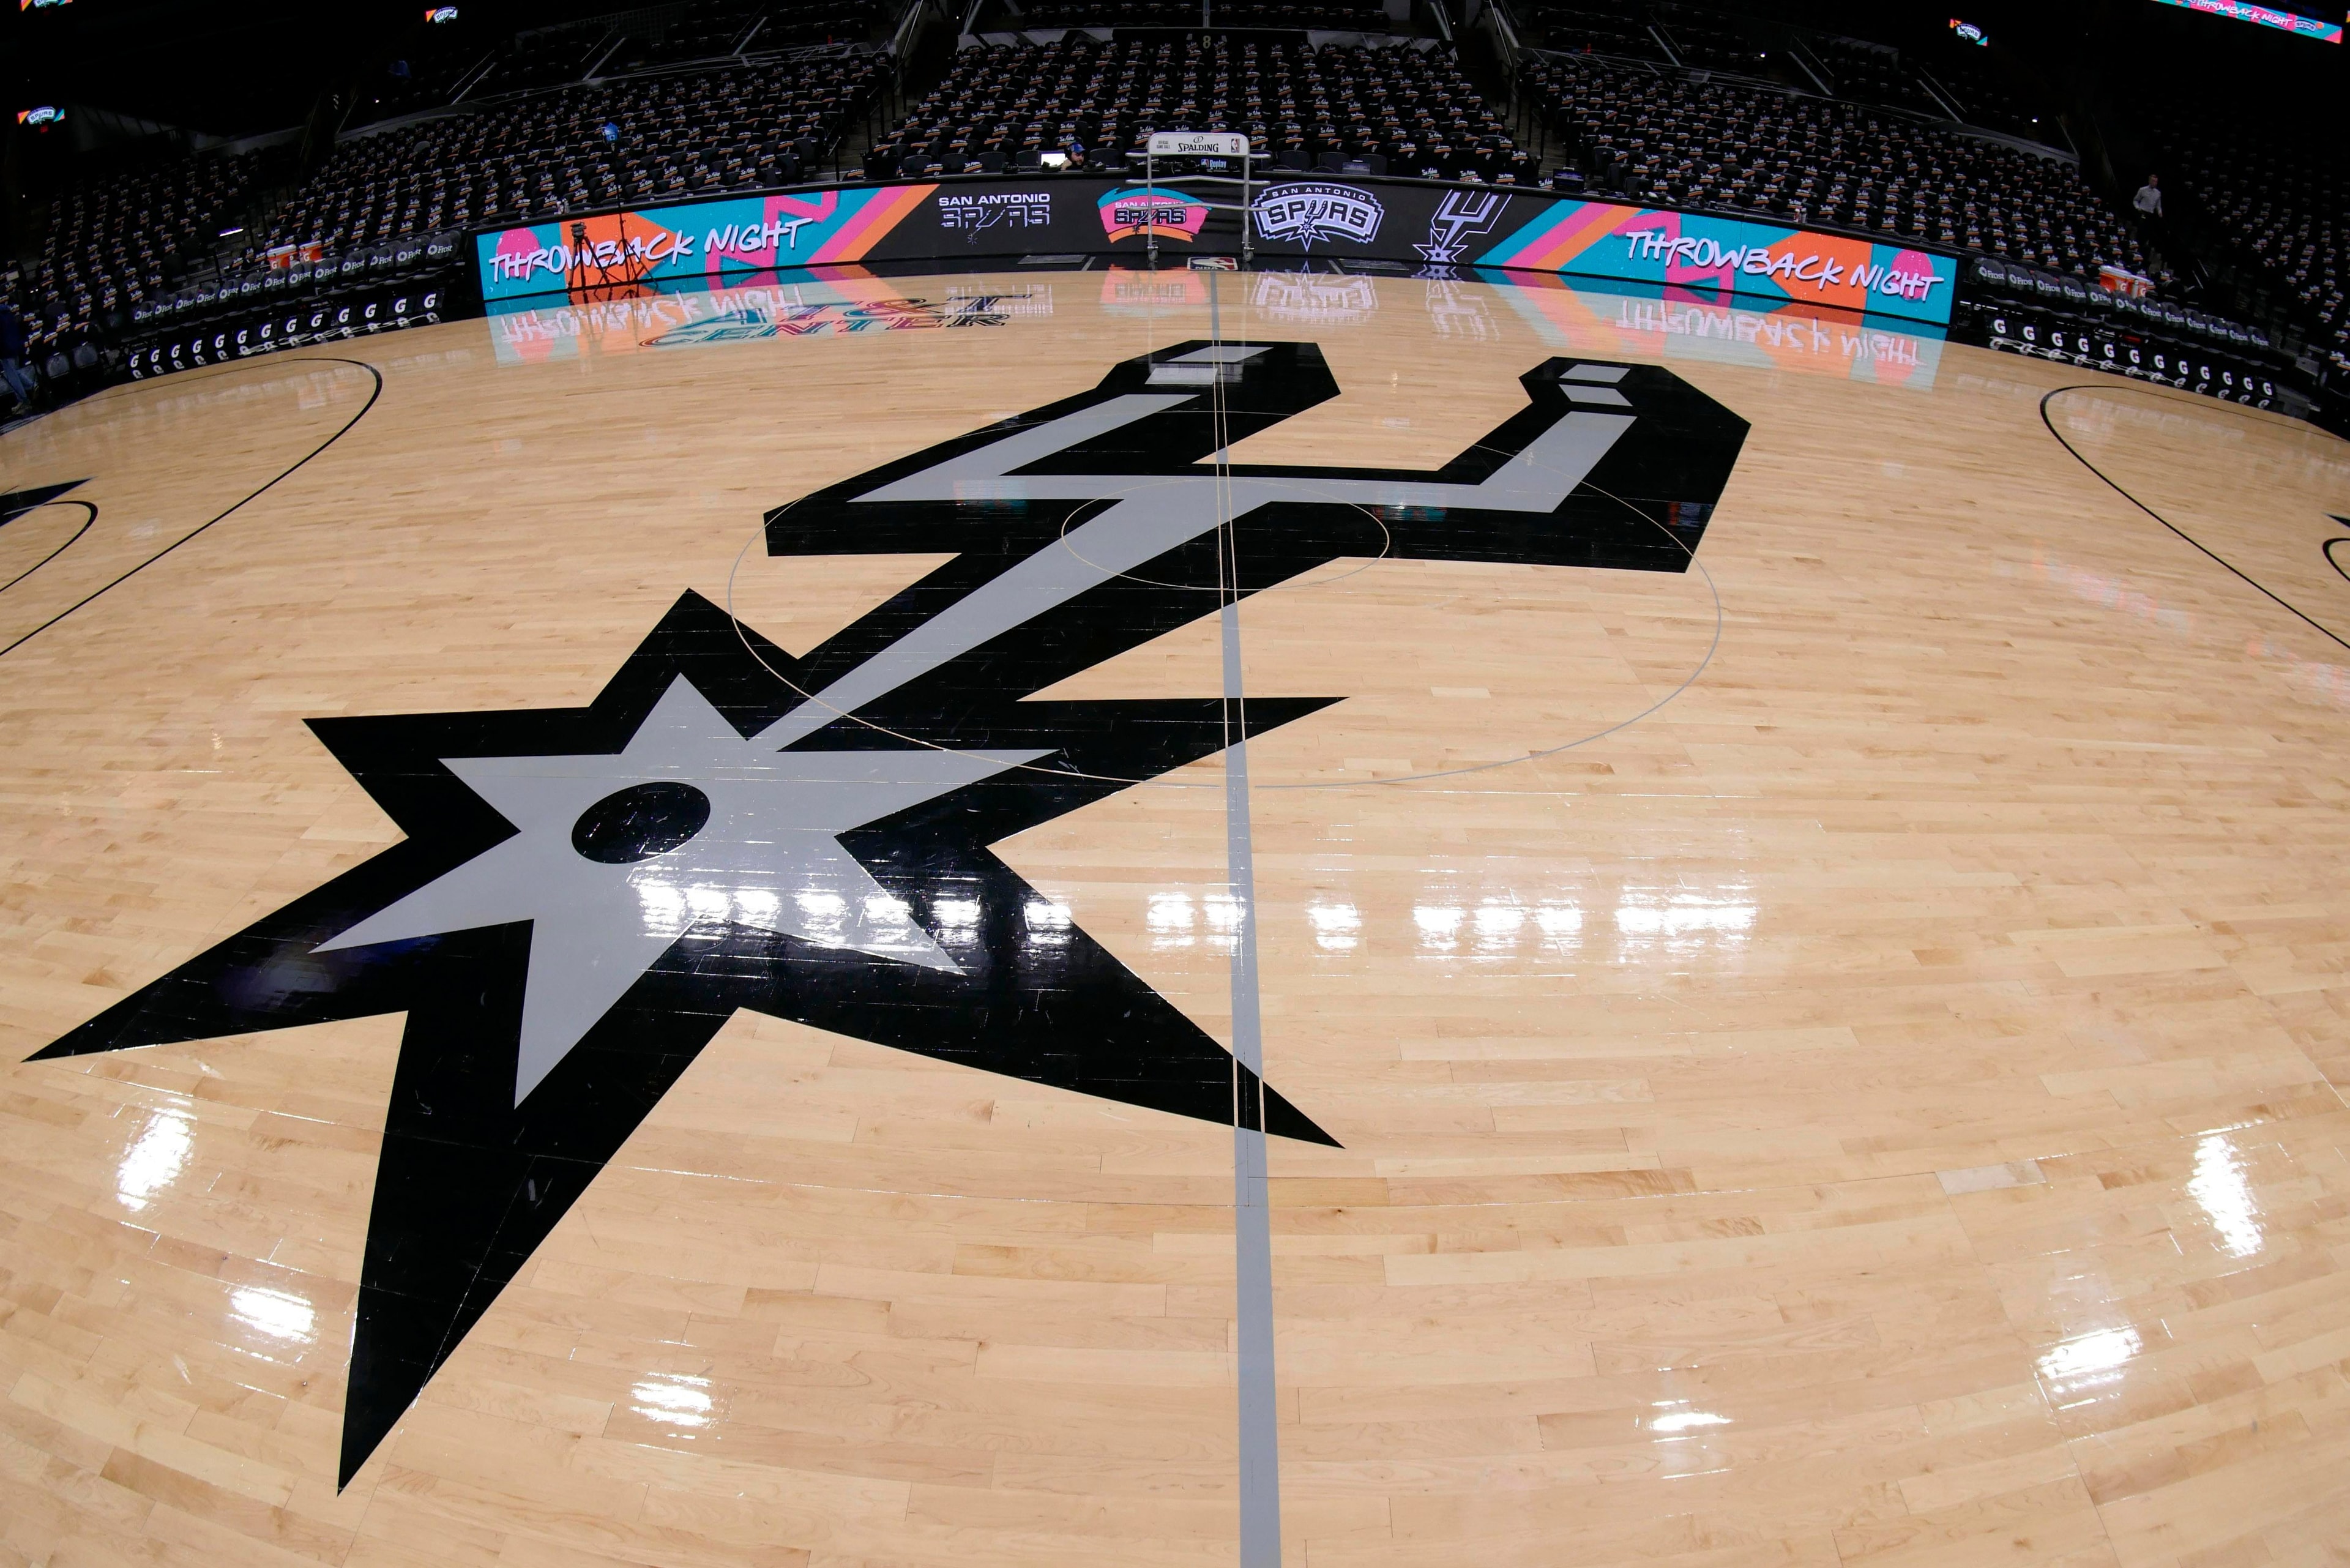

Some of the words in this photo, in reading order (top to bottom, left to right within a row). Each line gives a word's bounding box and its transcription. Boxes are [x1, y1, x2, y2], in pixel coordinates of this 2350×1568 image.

[2261, 14, 2294, 26] NIGHT
[1203, 35, 1211, 50] 8
[1178, 143, 1218, 152] SPALDING
[1209, 159, 1227, 169] Replay
[939, 196, 973, 206] SAN
[977, 193, 1051, 204] ANTONIO
[1272, 187, 1299, 198] SAN
[1305, 187, 1366, 201] ANTONIO
[408, 248, 422, 259] Frost
[438, 245, 453, 254] Frost
[489, 230, 695, 283] THROWBACK
[704, 217, 813, 253] NIGHT
[351, 259, 365, 269] Frost
[378, 255, 393, 264] Frost
[324, 266, 338, 276] Frost
[1625, 231, 1844, 290] THROWBACK
[1849, 264, 1945, 303] NIGHT
[1988, 270, 2005, 280] Frost
[2016, 276, 2034, 286] Frost
[394, 298, 407, 313] G
[423, 293, 436, 308] G
[338, 308, 350, 323] G
[365, 304, 377, 318] G
[668, 294, 1032, 331] AT&T
[286, 318, 297, 333] G
[311, 313, 323, 327] G
[1994, 319, 2006, 334] G
[237, 330, 247, 344] G
[261, 323, 272, 338] G
[638, 314, 1012, 348] CENTER
[2023, 326, 2035, 340] G
[192, 339, 203, 354] G
[215, 334, 225, 348] G
[2051, 332, 2064, 347] G
[2078, 338, 2089, 353] G
[151, 349, 160, 363] G
[171, 344, 181, 359] G
[2104, 344, 2115, 358] G
[2129, 349, 2140, 364] G
[130, 354, 140, 368] G
[2154, 354, 2165, 368] G
[2178, 360, 2188, 375] G
[2199, 366, 2210, 380] G
[2222, 371, 2232, 386] G
[2243, 377, 2253, 390] G
[2262, 382, 2273, 395] G
